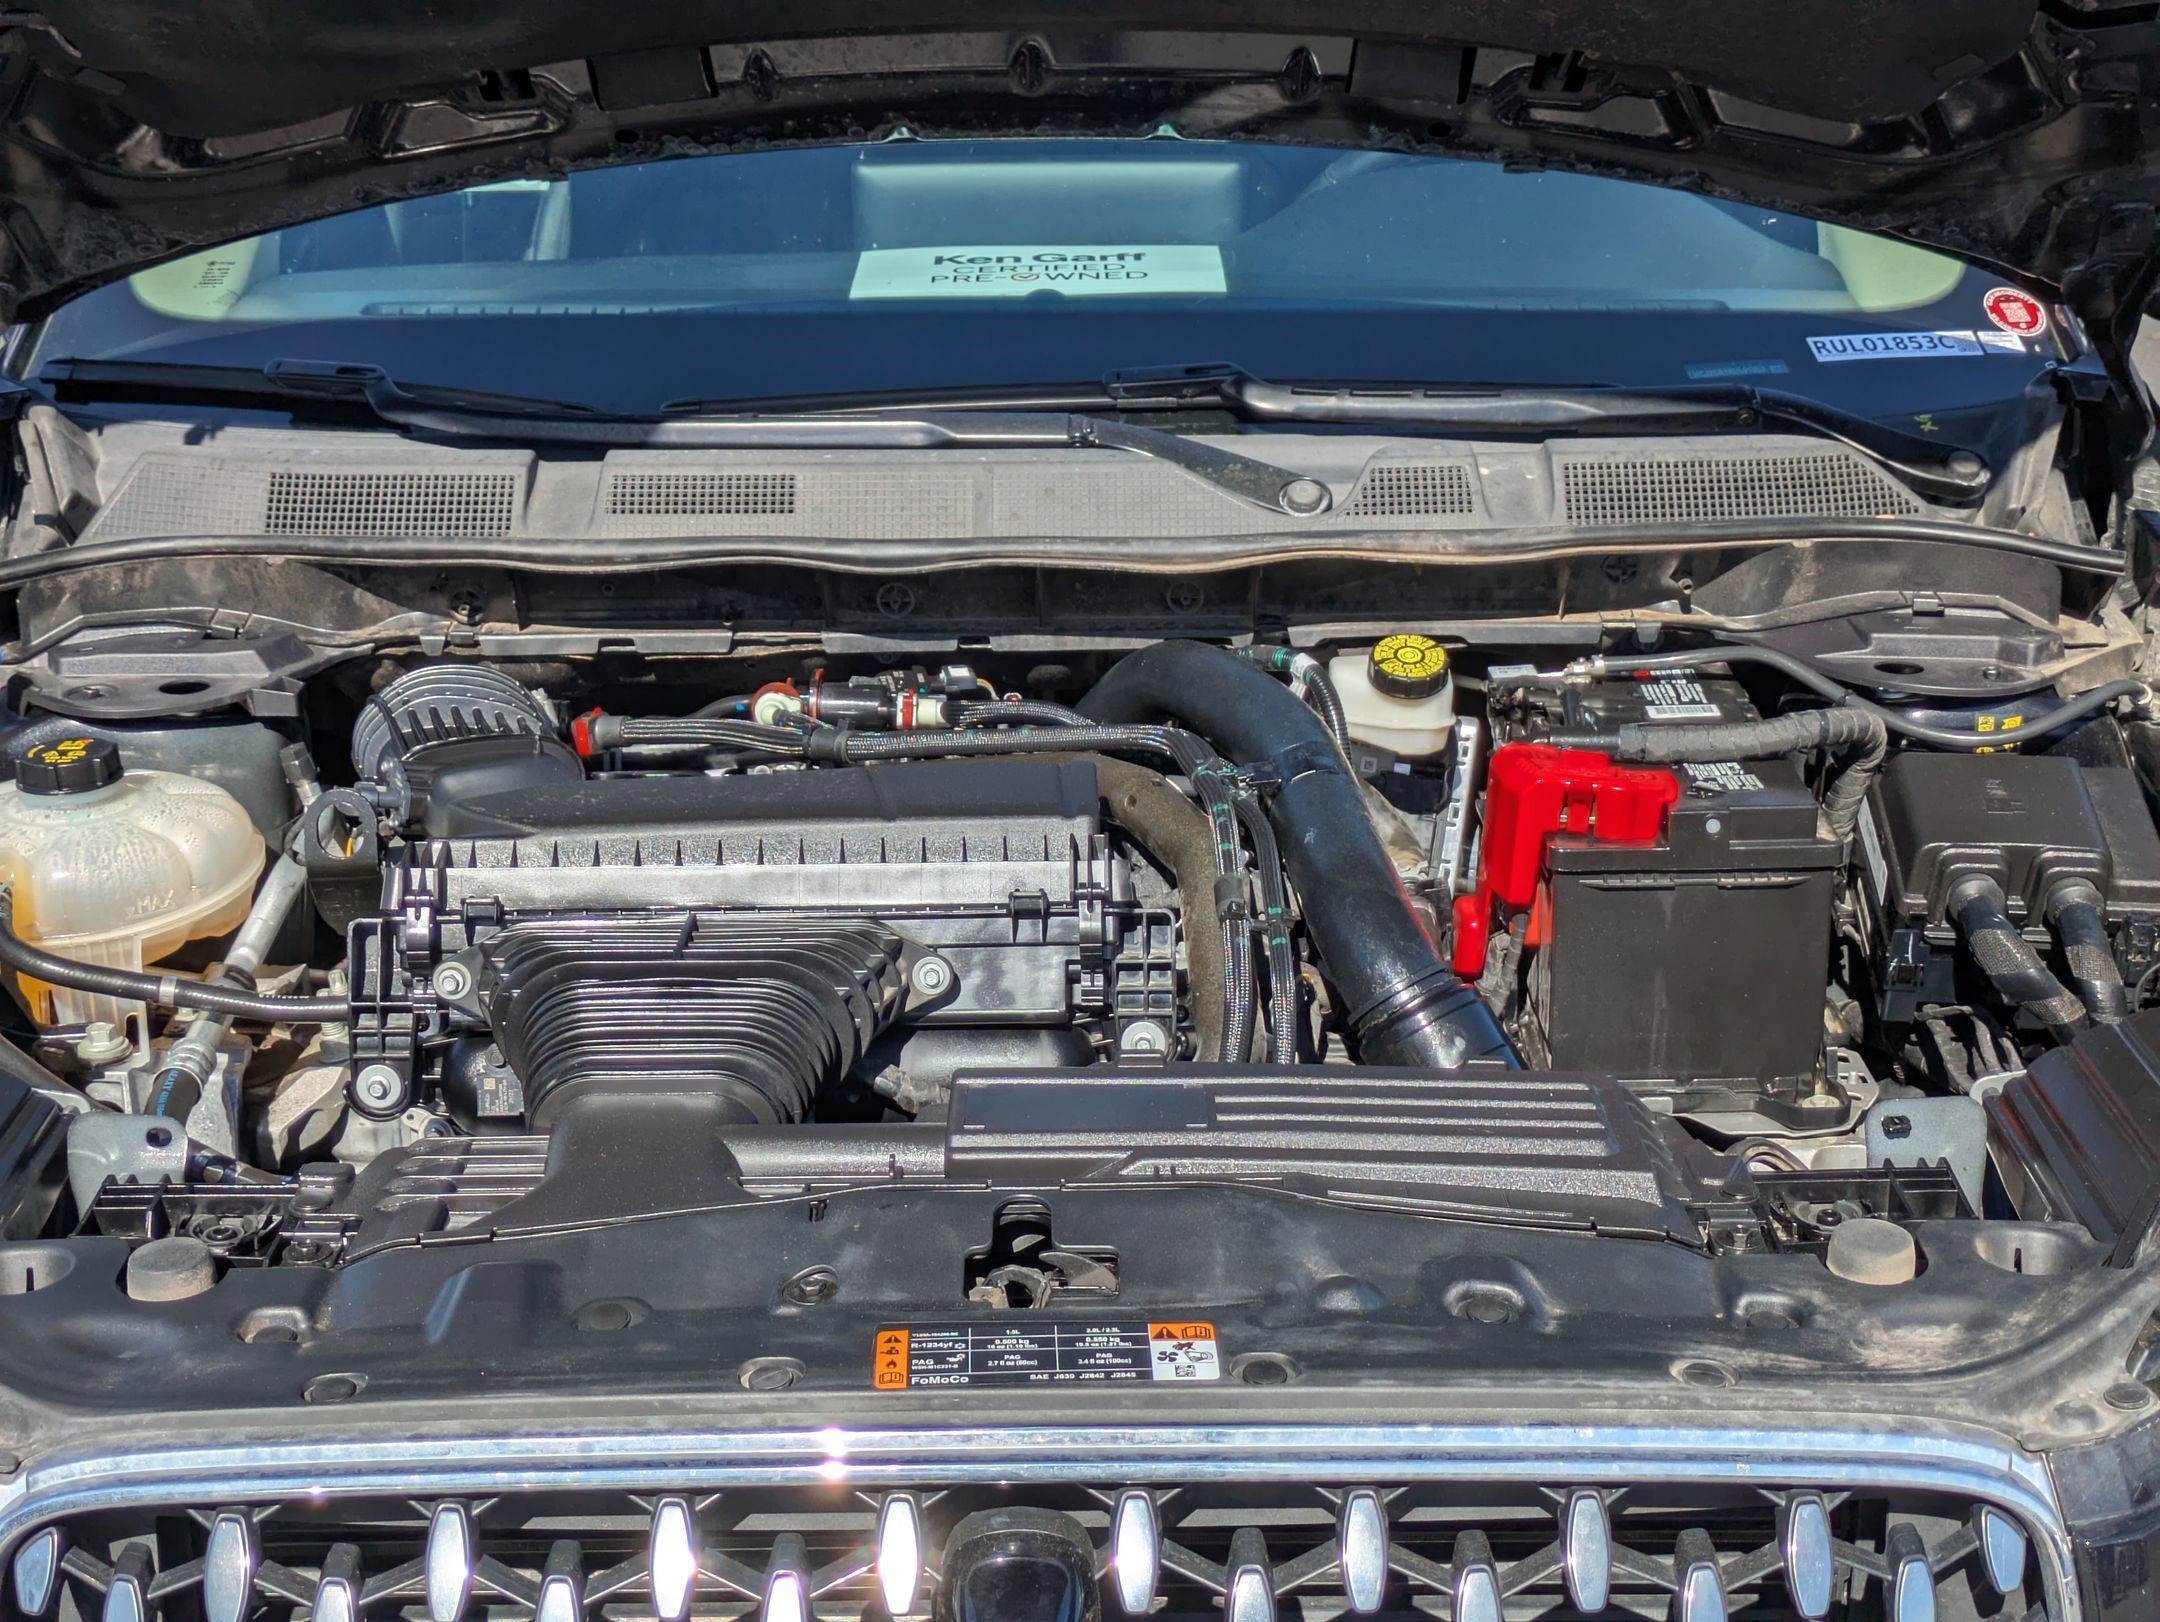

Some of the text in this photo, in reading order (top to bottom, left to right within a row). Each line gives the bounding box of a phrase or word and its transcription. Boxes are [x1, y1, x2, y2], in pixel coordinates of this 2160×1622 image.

[934, 254, 1022, 265] Ken
[952, 263, 1126, 274] CERTIFIED
[1812, 335, 1956, 354] RUL01853C
[910, 1341, 953, 1350] R-1234yf
[1018, 1338, 1029, 1346] kg
[911, 1358, 934, 1366] PAG
[911, 1375, 970, 1385] FoMoCo
